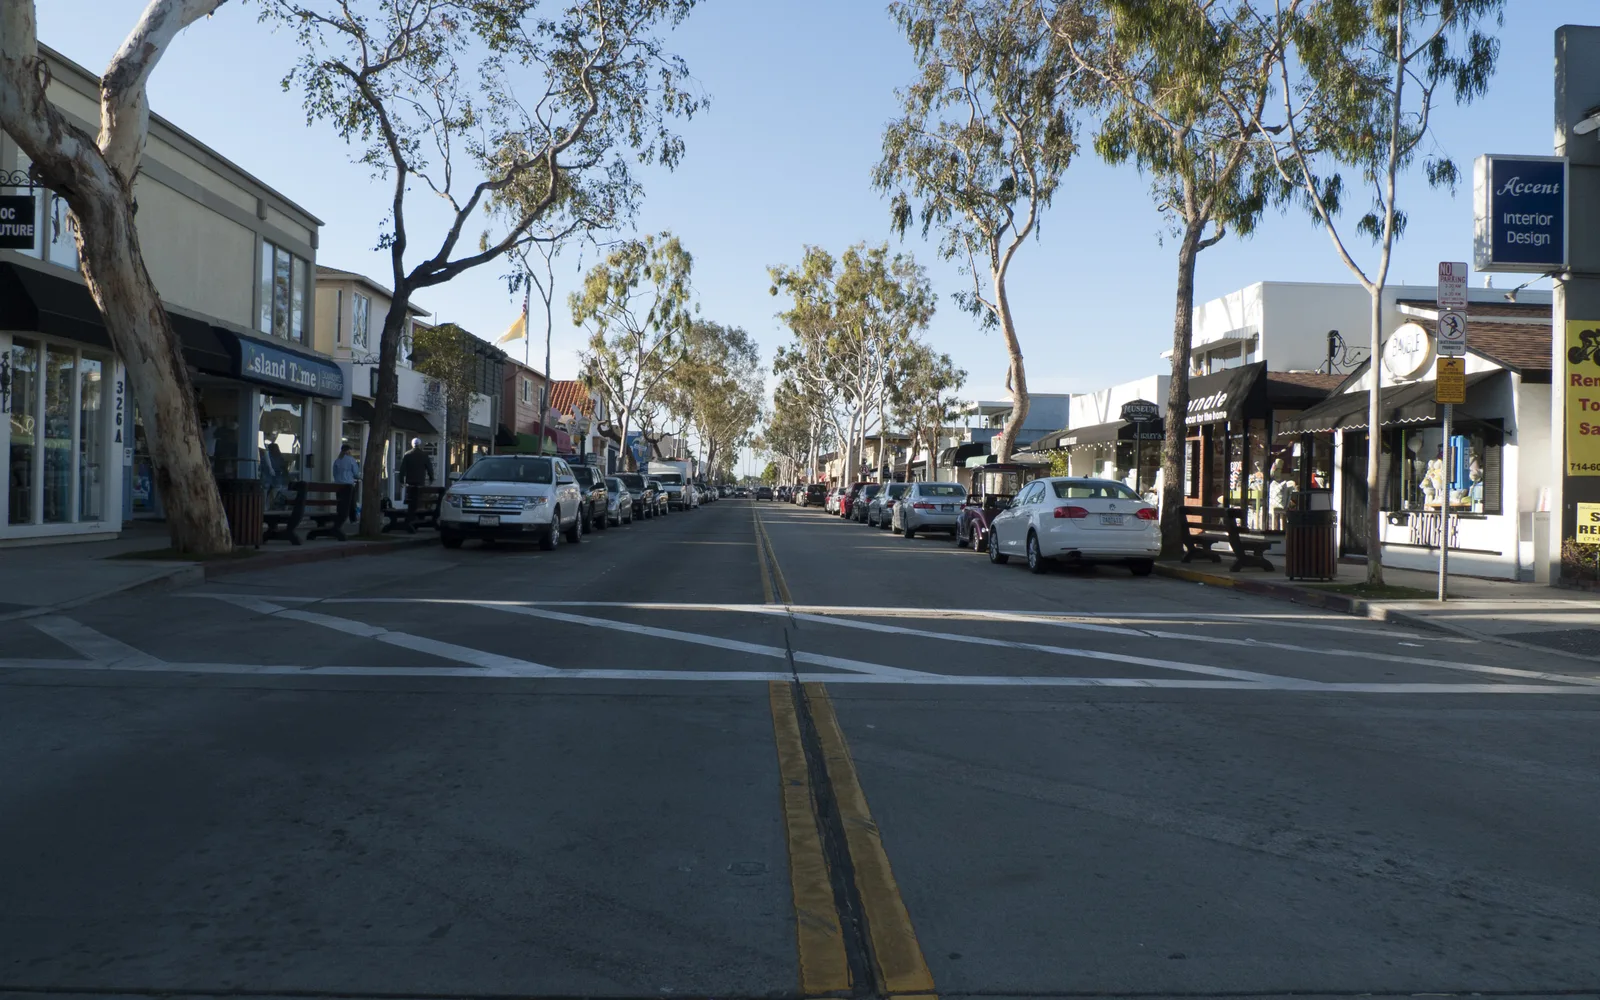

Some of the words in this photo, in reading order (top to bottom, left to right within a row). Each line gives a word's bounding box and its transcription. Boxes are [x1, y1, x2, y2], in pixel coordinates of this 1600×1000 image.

[1496, 176, 1560, 197] Accent
[1503, 212, 1554, 226] Interior
[1507, 231, 1550, 247] Design
[1440, 263, 1452, 275] NO
[289, 362, 317, 387] Time
[1124, 405, 1158, 415] MUSEUM
[1578, 398, 1600, 411] To
[115, 380, 124, 443] 326A
[1196, 413, 1204, 423] for
[1203, 411, 1212, 421] the
[1212, 410, 1227, 420] home
[1579, 422, 1600, 435] Sa
[1408, 512, 1459, 548] BAUBE
[1578, 525, 1600, 535] RE
